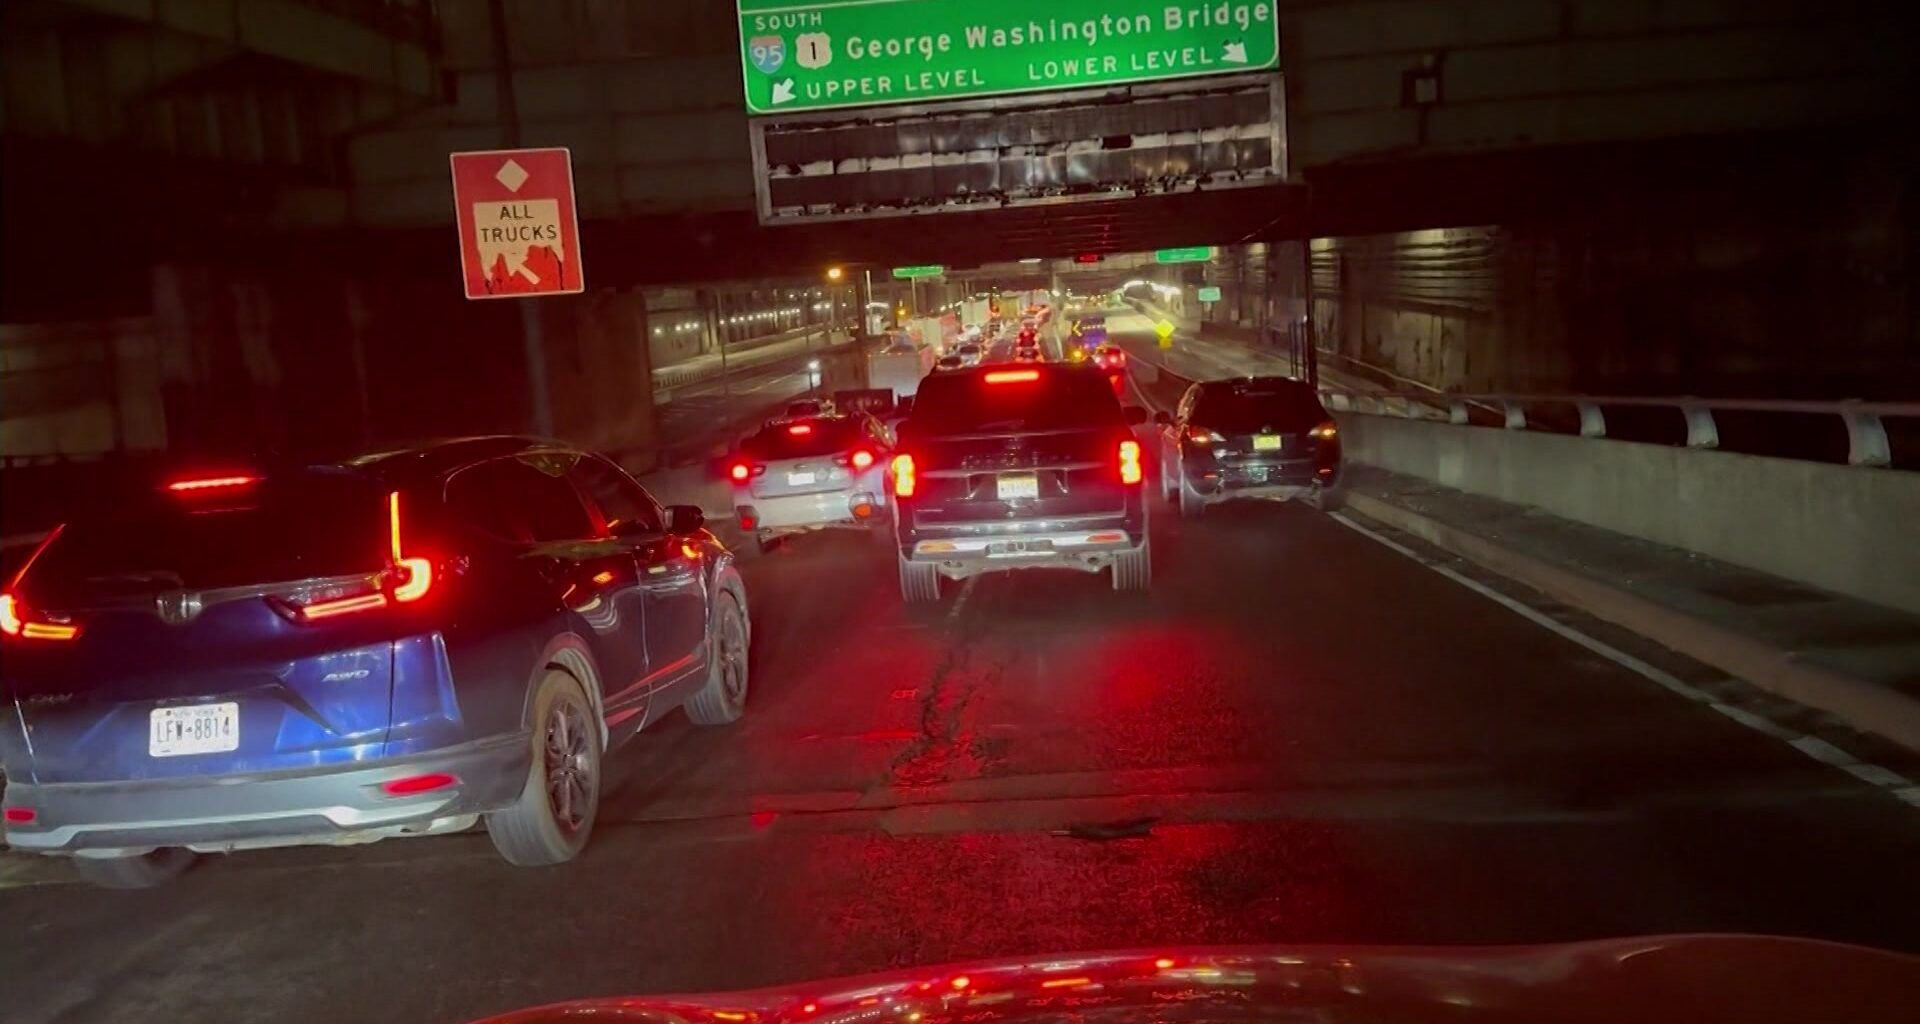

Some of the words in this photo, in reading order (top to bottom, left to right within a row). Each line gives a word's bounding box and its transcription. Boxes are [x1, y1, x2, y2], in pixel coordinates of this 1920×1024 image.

[755, 12, 822, 31] SOUTH
[846, 33, 951, 62] George
[965, 13, 1151, 50] Washington
[1163, 1, 1269, 31] Bridge
[752, 45, 784, 66] 95
[810, 41, 817, 61] 1
[1028, 55, 1117, 81] LOWER
[1131, 47, 1214, 71] LEVEL
[806, 75, 892, 99] UPPER
[904, 68, 985, 92] LEVEL
[500, 204, 535, 221] ALL
[480, 224, 558, 243] TRUCKS
